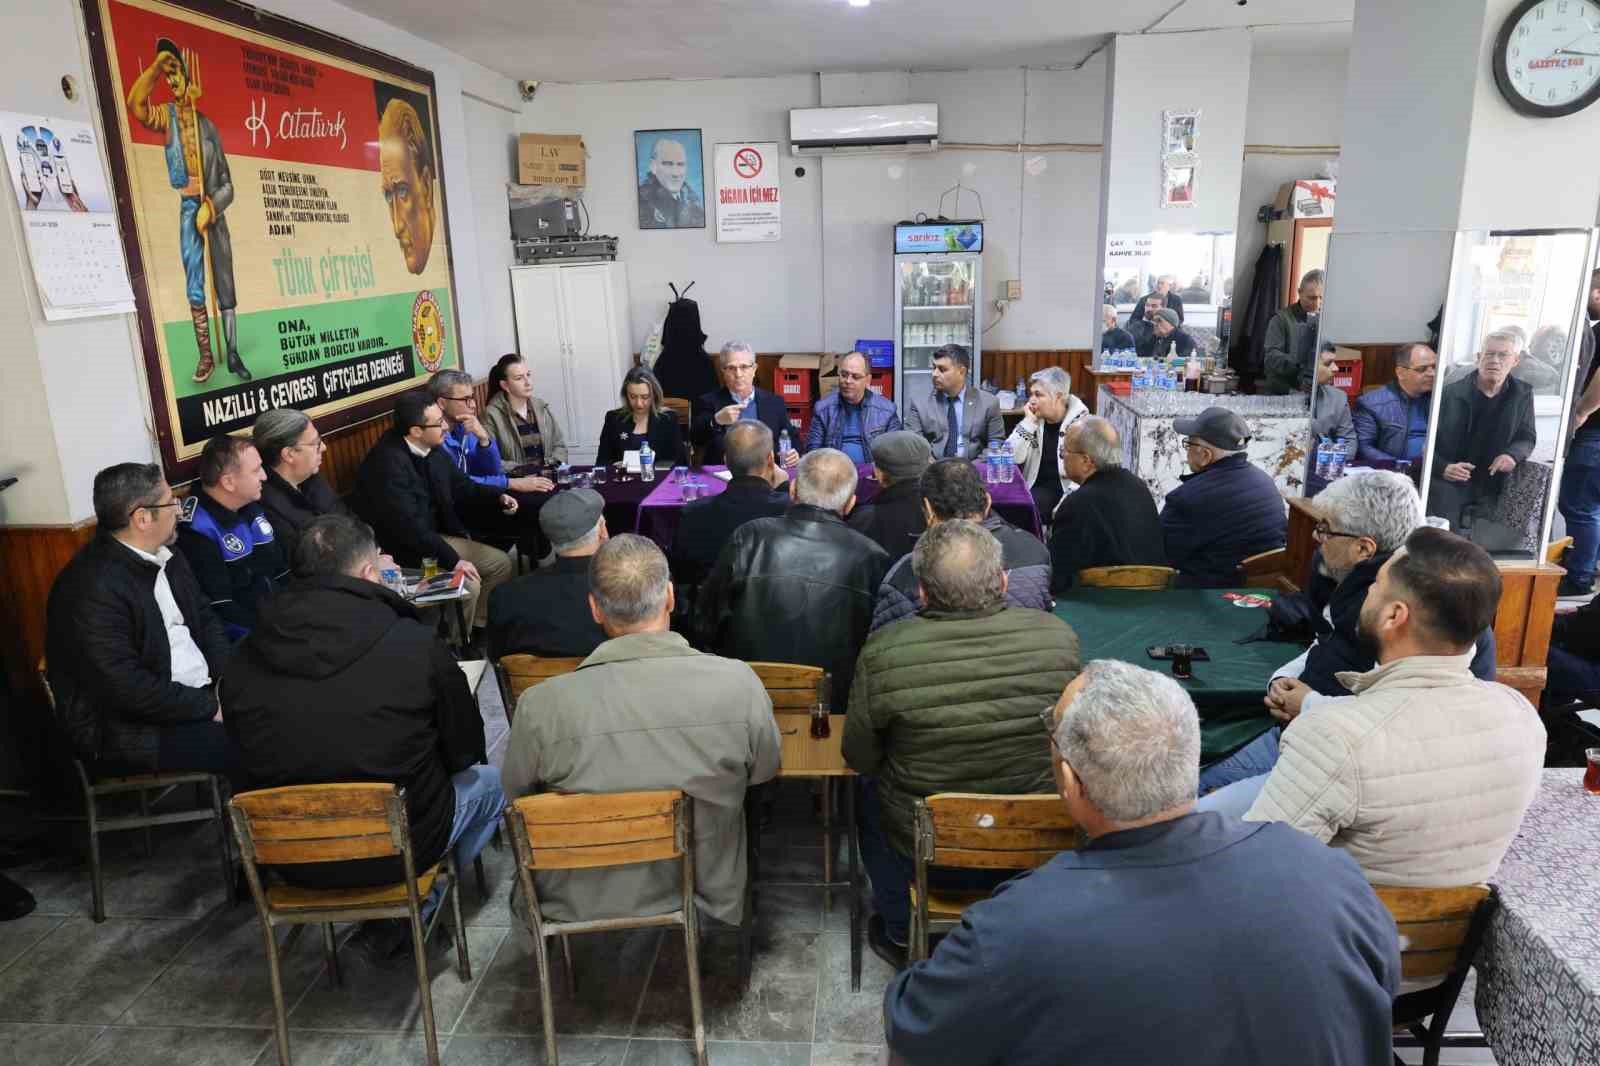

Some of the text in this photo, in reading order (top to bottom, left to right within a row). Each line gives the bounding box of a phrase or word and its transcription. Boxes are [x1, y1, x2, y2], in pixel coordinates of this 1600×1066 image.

[272, 244, 376, 298] TÜRK ÇİFTÇİSİ
[278, 319, 311, 334] ONA,
[280, 327, 360, 351] BÜTÜN MİLLETİN
[282, 348, 321, 370] ŞÜKRAN
[324, 341, 356, 359] BORCU
[203, 351, 405, 428] NAZİLLİ & ÇEVRESİ ÇİFTÇİLER DERNEĞİ
